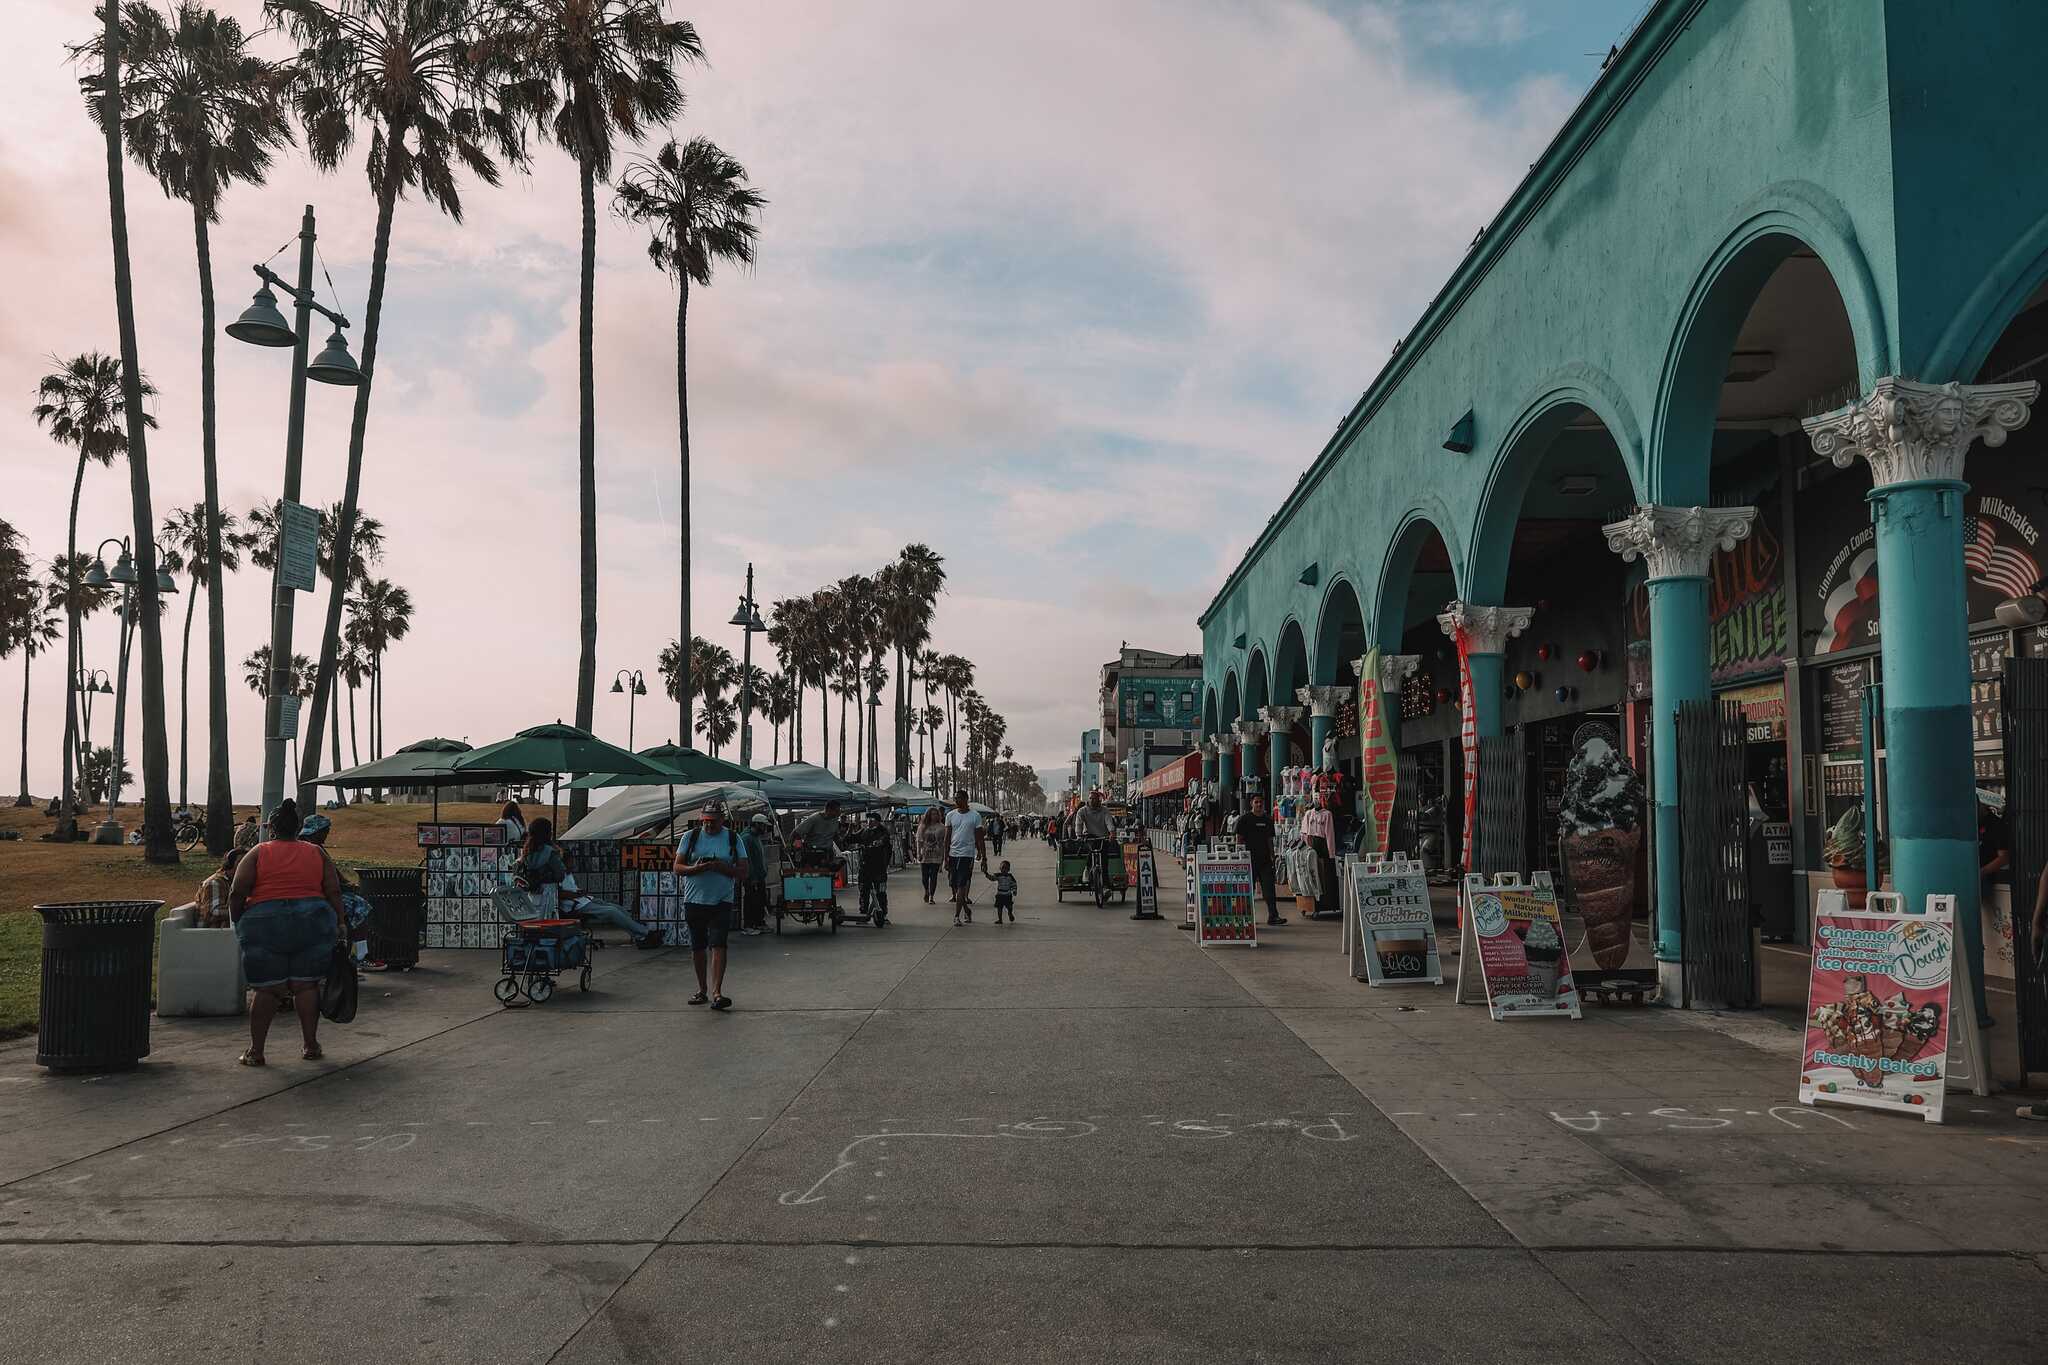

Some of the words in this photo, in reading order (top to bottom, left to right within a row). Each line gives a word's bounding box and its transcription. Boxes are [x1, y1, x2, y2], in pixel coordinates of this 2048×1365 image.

[1979, 495, 2039, 547] Milkshakes
[1817, 545, 1850, 601] Cinnamon
[1849, 525, 1875, 552] Cones
[1711, 584, 1787, 669] ENICE
[1867, 619, 1879, 637] So
[1748, 725, 1771, 742] SIDE
[1765, 825, 1789, 835] ATM
[1770, 841, 1790, 851] ATM
[621, 844, 676, 869] HEN
[640, 859, 674, 871] TATT
[1141, 861, 1153, 897] ATM
[1187, 866, 1196, 905] ATM
[1365, 895, 1425, 906] COFFEE
[1503, 895, 1526, 904] World
[1366, 911, 1430, 924] Chocolate
[1819, 926, 1898, 943] Cinnamon
[1828, 939, 1853, 950] cake
[1854, 940, 1887, 950] cones
[1900, 933, 1935, 956] Turn
[1820, 948, 1843, 960] with
[1843, 950, 1864, 961] soft
[1864, 951, 1895, 962] serve
[1895, 940, 1951, 979] Dough
[1816, 956, 1841, 971] ice
[1844, 958, 1896, 975] cream
[1814, 1050, 1877, 1075] Freshly
[1879, 1058, 1937, 1078] Baked
